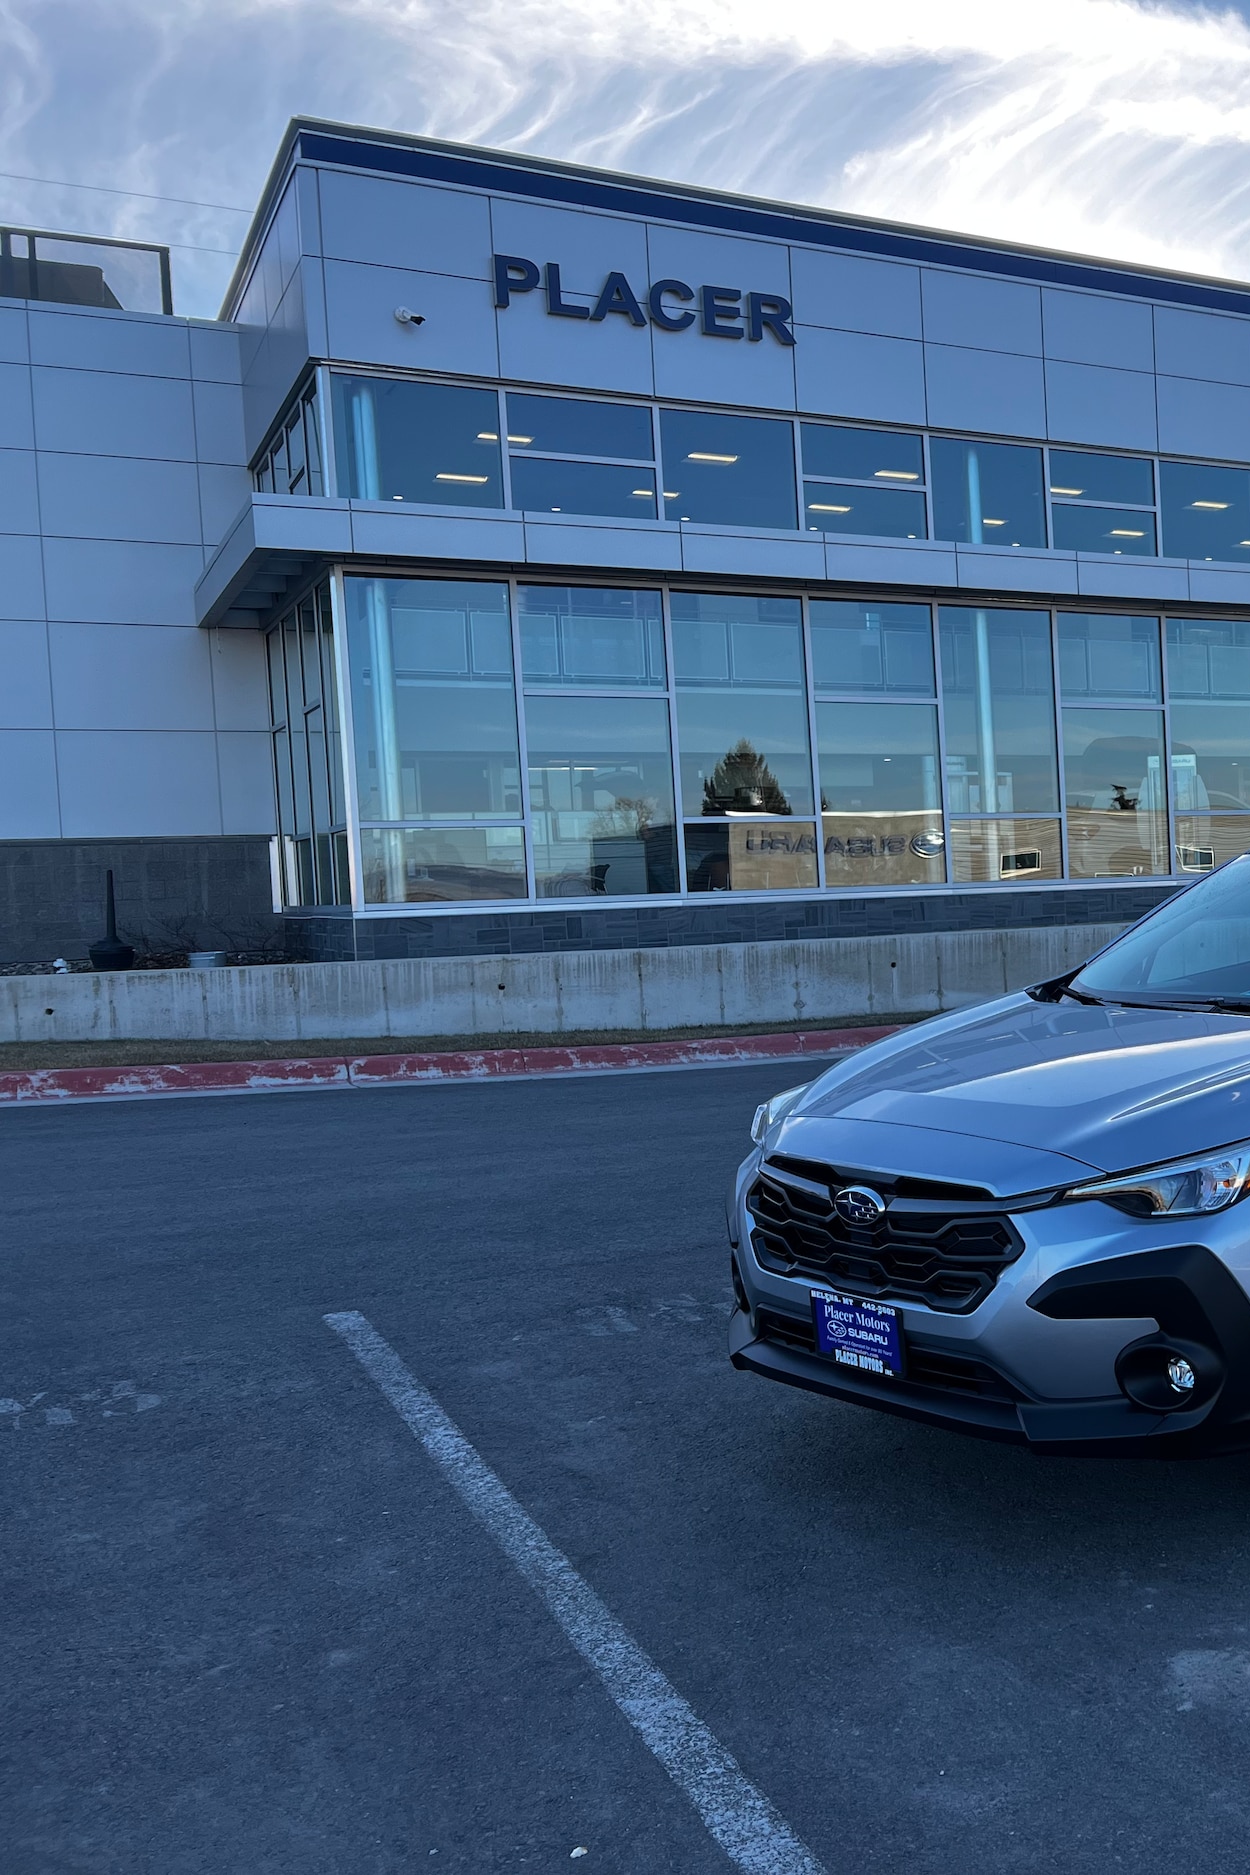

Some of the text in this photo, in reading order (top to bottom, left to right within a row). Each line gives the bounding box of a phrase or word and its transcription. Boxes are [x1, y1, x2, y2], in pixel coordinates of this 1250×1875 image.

[493, 253, 797, 346] PLACER
[842, 1296, 854, 1306] MT
[823, 1304, 890, 1333] Placer Motors
[848, 1328, 888, 1346] SUBARU
[835, 1349, 858, 1367] PLACER
[859, 1354, 884, 1373] MOTORS
